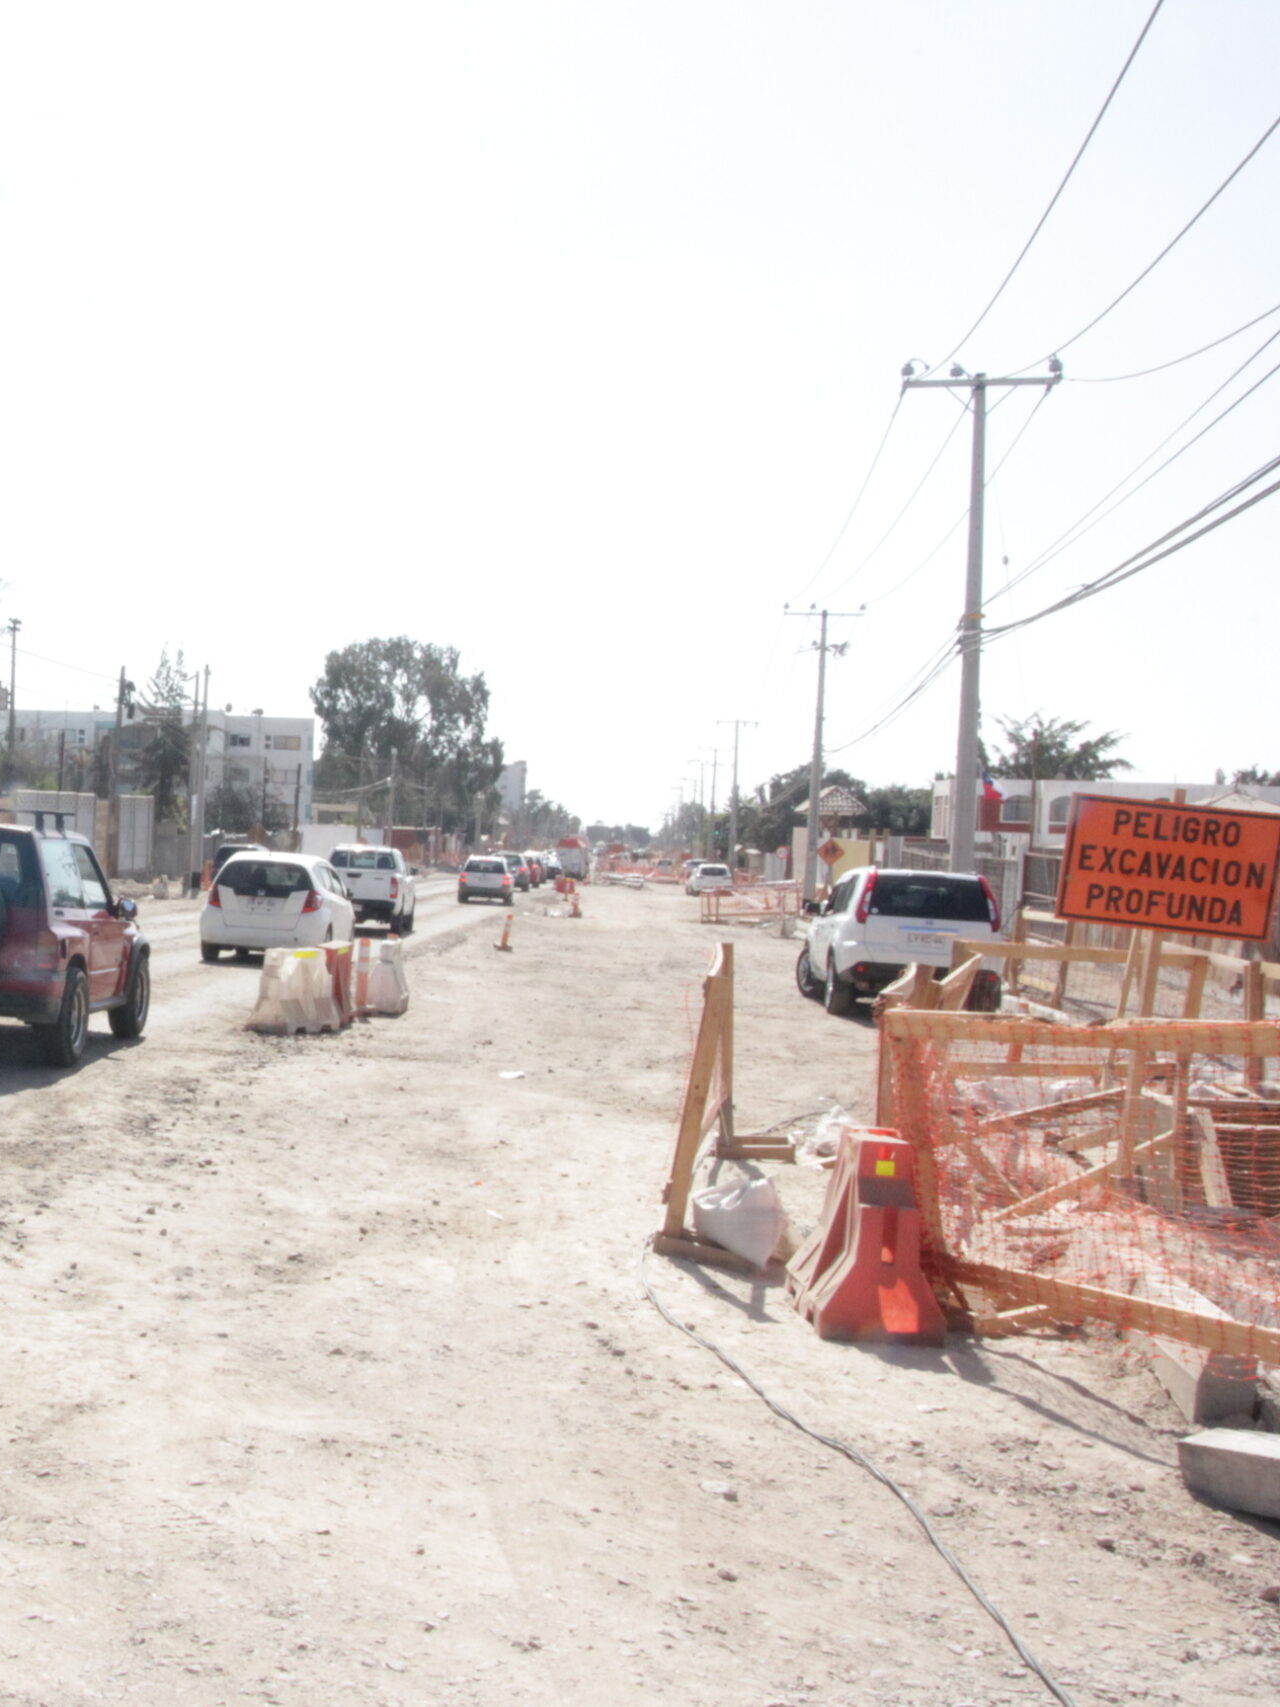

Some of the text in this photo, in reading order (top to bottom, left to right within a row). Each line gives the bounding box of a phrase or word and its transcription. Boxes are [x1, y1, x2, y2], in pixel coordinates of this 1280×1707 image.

[1112, 808, 1241, 847] PELIGRO
[1078, 844, 1266, 889] EXCAVACION
[1085, 883, 1242, 927] PROFUNDA
